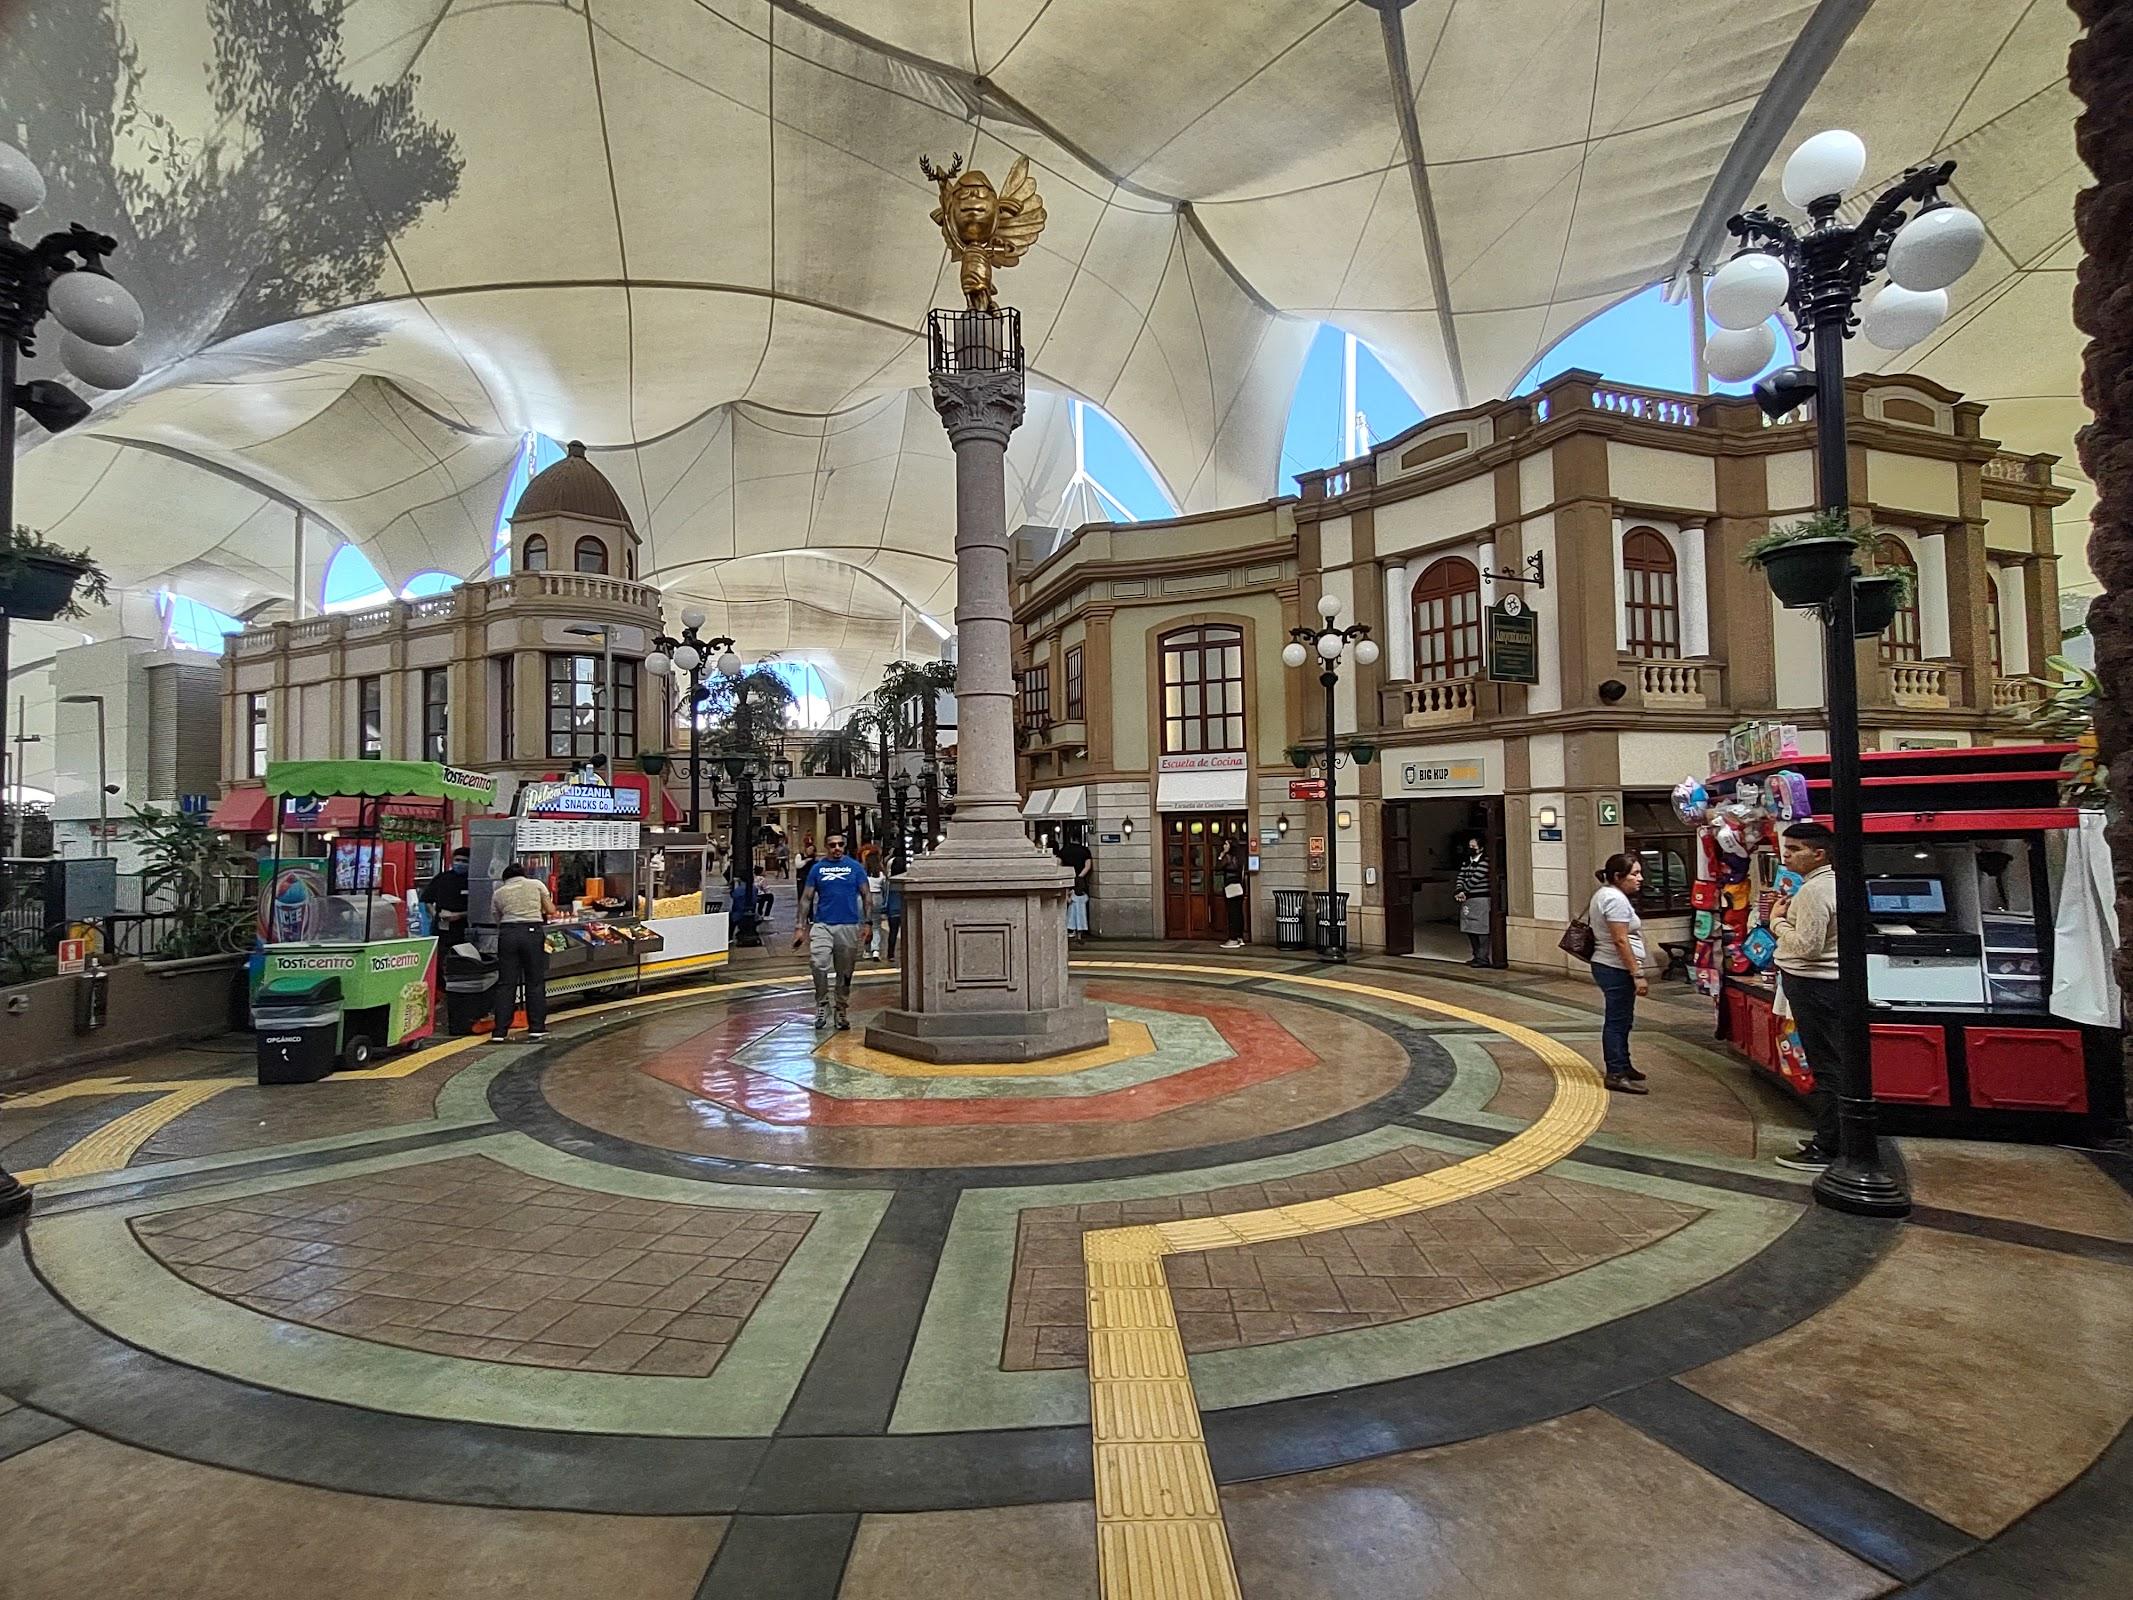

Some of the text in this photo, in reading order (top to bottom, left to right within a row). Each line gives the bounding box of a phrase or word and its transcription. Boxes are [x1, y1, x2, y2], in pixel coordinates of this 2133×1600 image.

[1162, 756, 1243, 769] Escuela de Cocina
[1419, 769, 1432, 781] BIG
[1433, 768, 1449, 780] KUP
[564, 786, 611, 798] KIDZANIA
[564, 799, 597, 810] SNACKS
[819, 866, 852, 874] Reebok
[280, 908, 302, 923] ICEE
